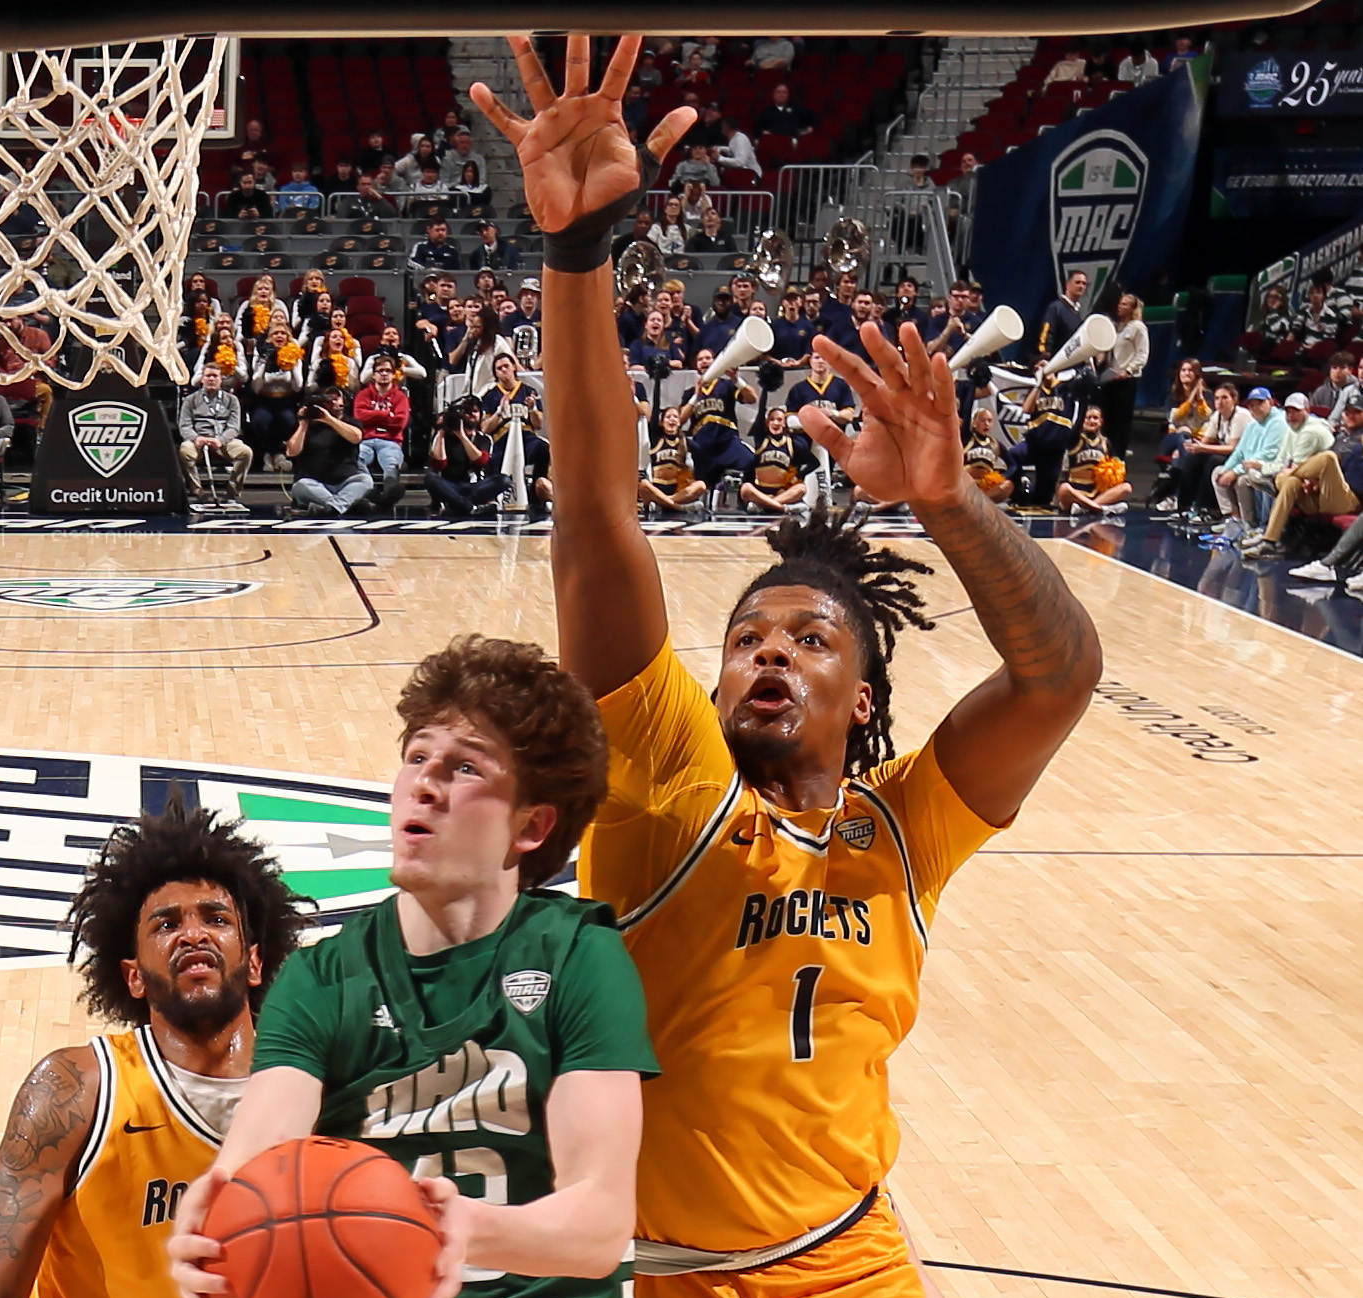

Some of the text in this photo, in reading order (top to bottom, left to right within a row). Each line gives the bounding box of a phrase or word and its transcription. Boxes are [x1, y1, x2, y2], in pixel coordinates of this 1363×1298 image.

[1278, 61, 1337, 107] 25
[1054, 203, 1135, 254] MAC
[77, 426, 138, 444] MAC
[51, 487, 103, 503] Credit
[105, 487, 155, 503] Union
[1140, 722, 1260, 764] Credit
[842, 824, 875, 840] MAC
[734, 888, 874, 951] ROCKETS
[508, 984, 548, 997] MAC
[790, 963, 826, 1063] 1
[361, 1039, 532, 1139] OHIO
